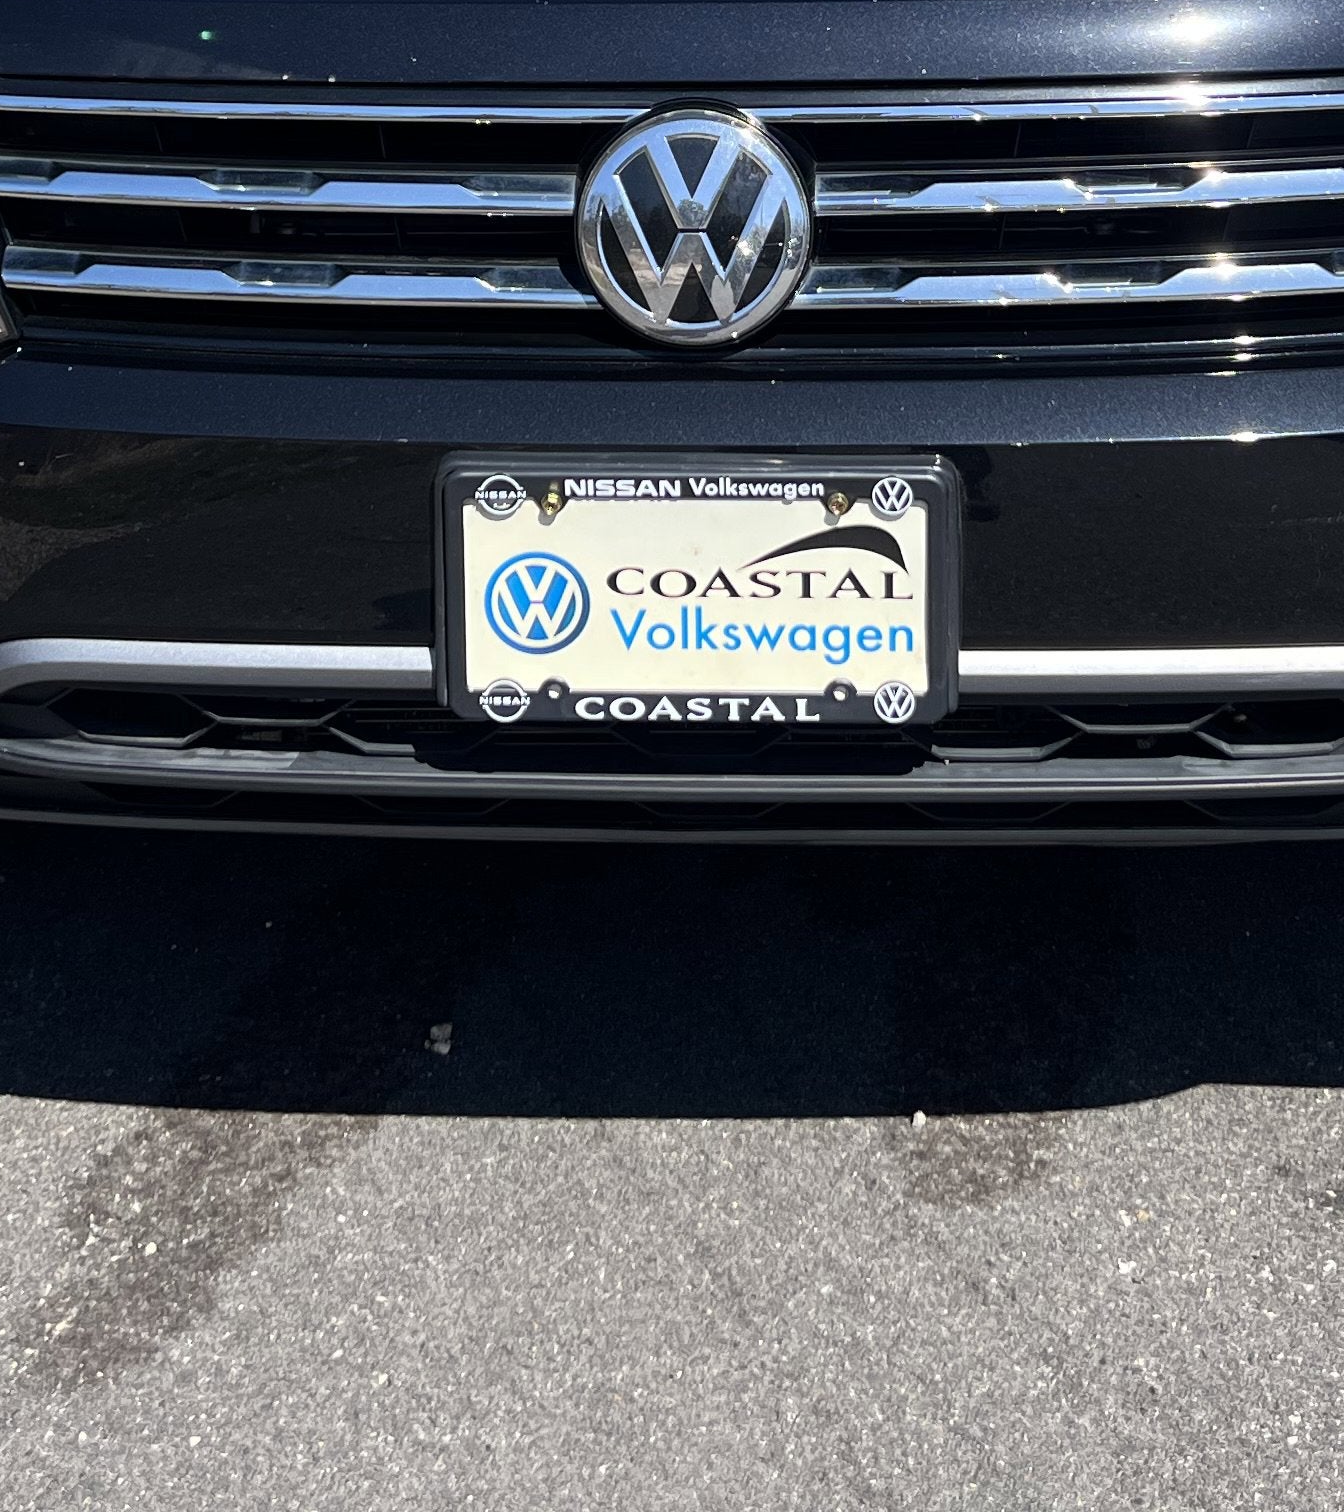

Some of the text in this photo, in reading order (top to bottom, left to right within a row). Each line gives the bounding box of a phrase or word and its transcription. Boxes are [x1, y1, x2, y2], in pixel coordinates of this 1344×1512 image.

[564, 477, 824, 500] NISSAN Volkswagen
[606, 567, 914, 600] COASTAL
[610, 605, 914, 664] Volkswagen
[574, 696, 821, 722] COASTAL
